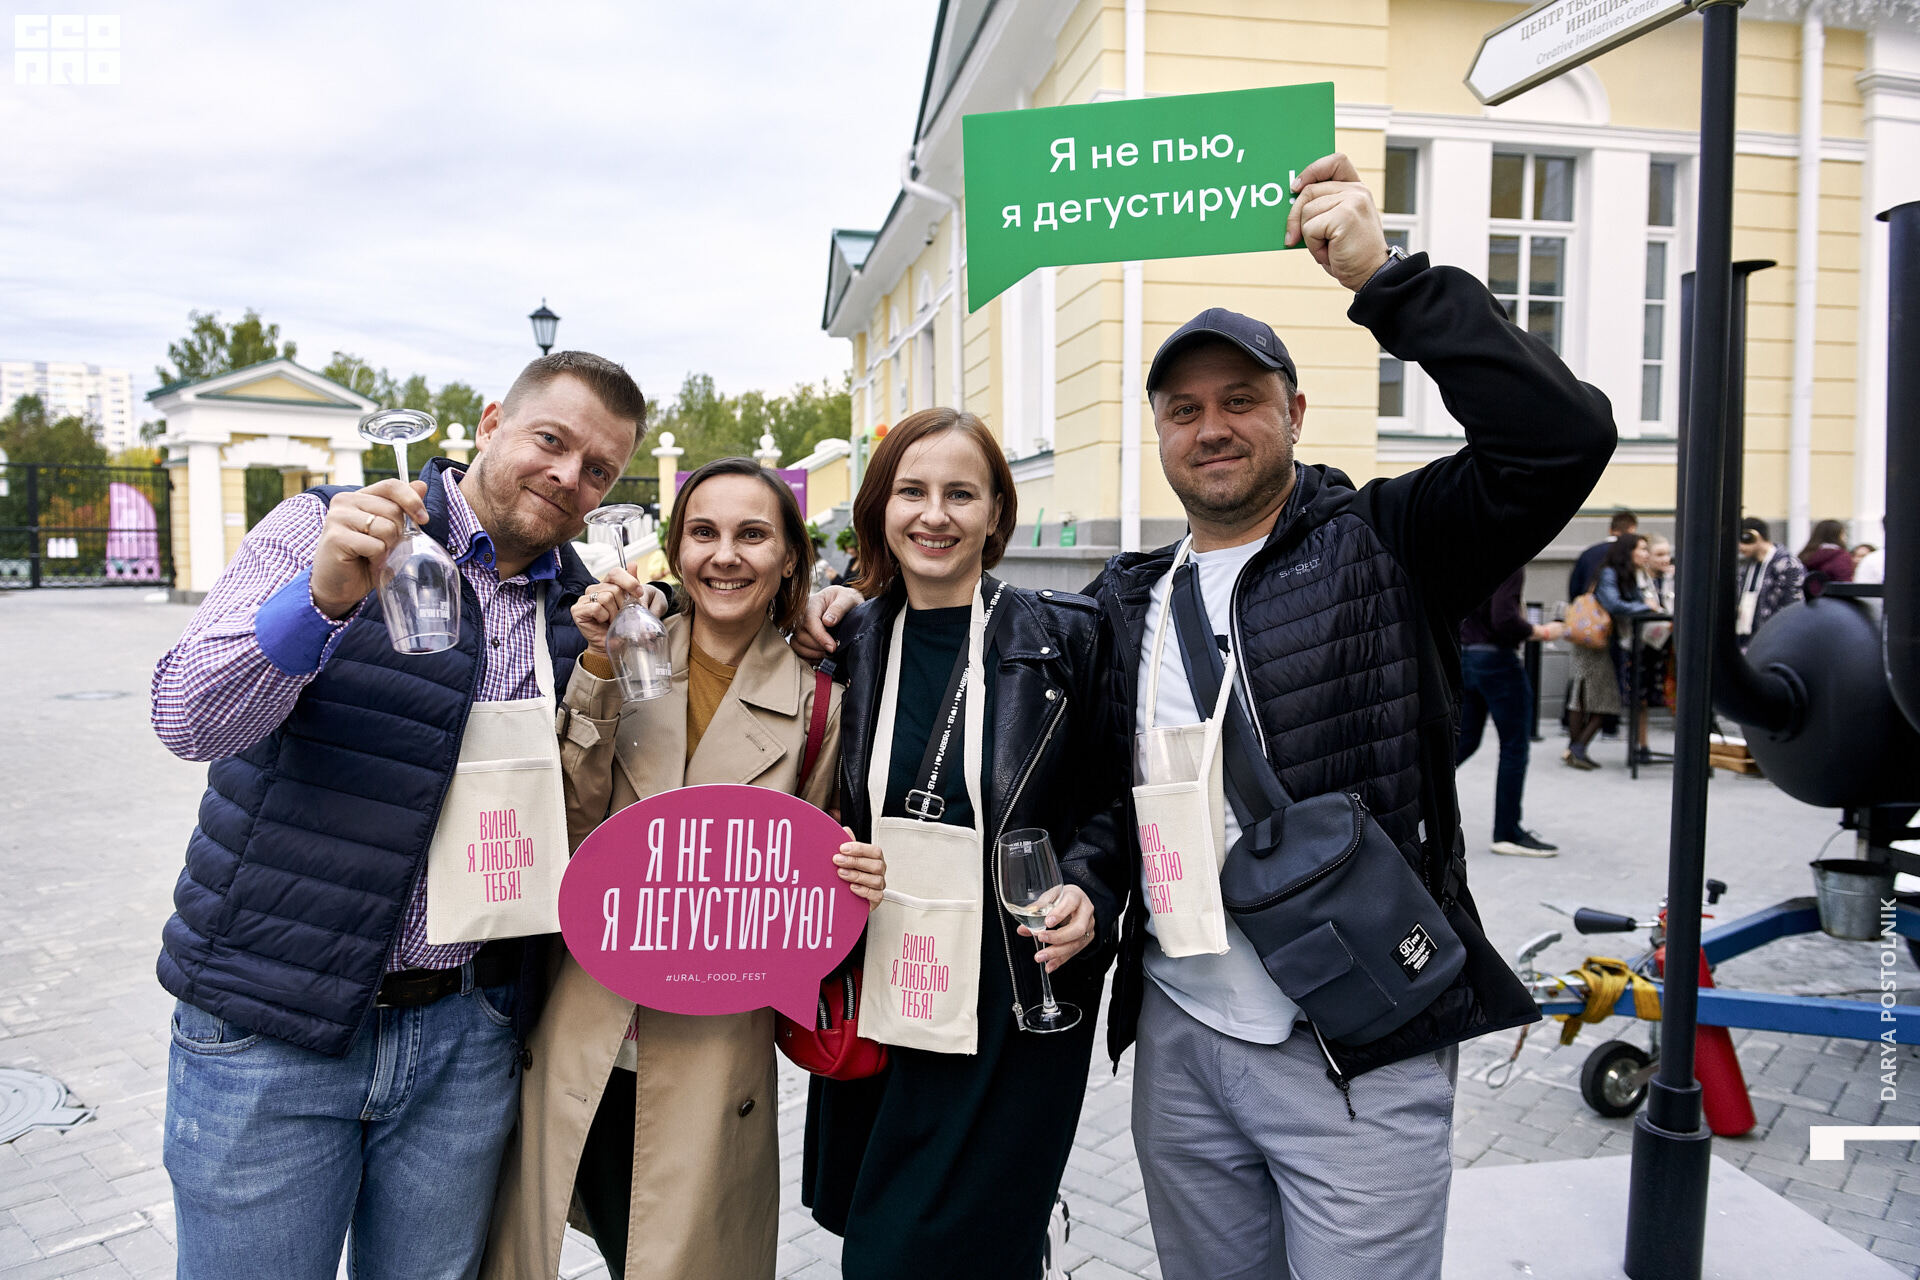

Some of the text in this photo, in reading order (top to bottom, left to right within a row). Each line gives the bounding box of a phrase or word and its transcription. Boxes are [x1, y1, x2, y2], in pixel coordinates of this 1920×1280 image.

[1520, 9, 1564, 42] ЦЕНТР
[1536, 37, 1574, 65] Creative
[1575, 12, 1624, 45] Initiatives
[1050, 134, 1245, 173] Я не пью,
[1001, 169, 1297, 232] я дегустирую!
[1279, 558, 1320, 578] SPORT
[480, 808, 521, 840] ВИНО,
[1139, 823, 1166, 853] ИНО,
[467, 837, 534, 873] Я ЛЮБЛЮ
[645, 818, 800, 885] Я НЕ ПЬЮ,
[483, 870, 522, 903] ТЕБЯ!
[600, 886, 836, 951] Я ДЕГУСТИРУЮ!
[902, 932, 938, 964] ВИНО,
[665, 972, 767, 983] #URAL_FOOD_FEST
[890, 959, 949, 992] Я ЛЮБЛЮ
[901, 989, 934, 1020] ТЕБЯ!
